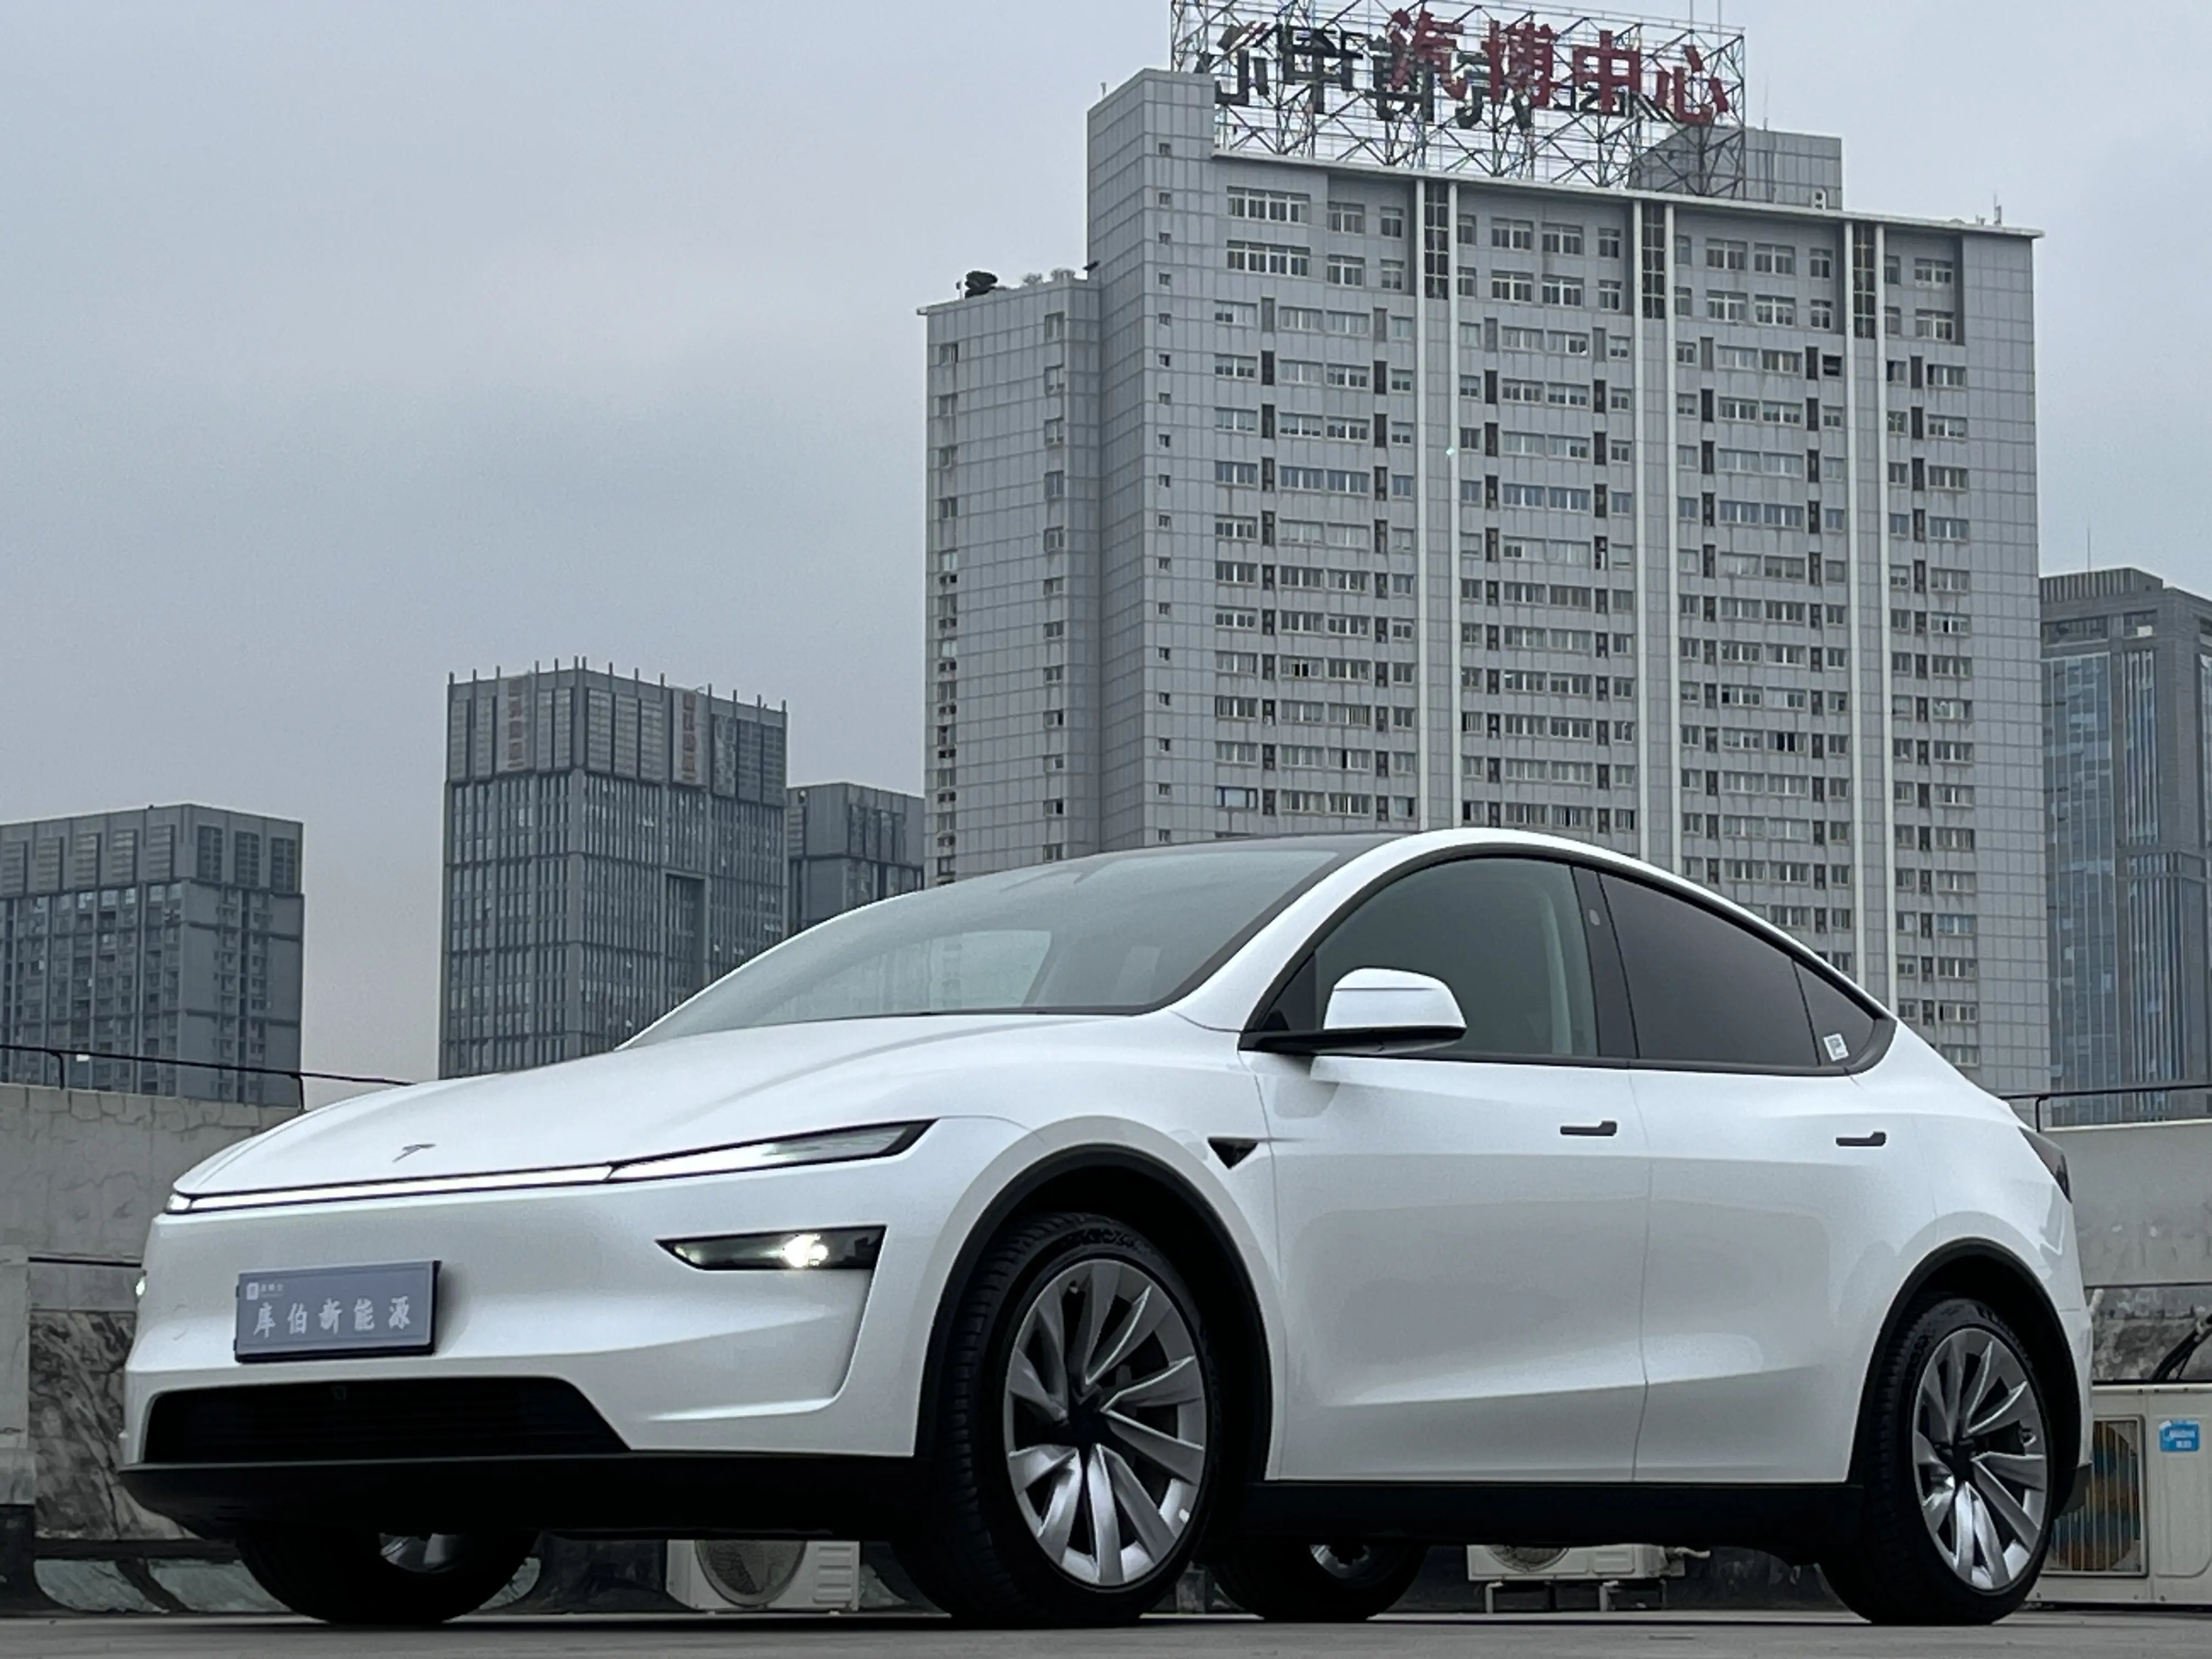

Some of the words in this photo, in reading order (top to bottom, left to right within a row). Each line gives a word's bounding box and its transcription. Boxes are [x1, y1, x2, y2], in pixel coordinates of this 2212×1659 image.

[1386, 8, 1728, 125] 汽博中心
[253, 1295, 410, 1339] 库伯新能源
